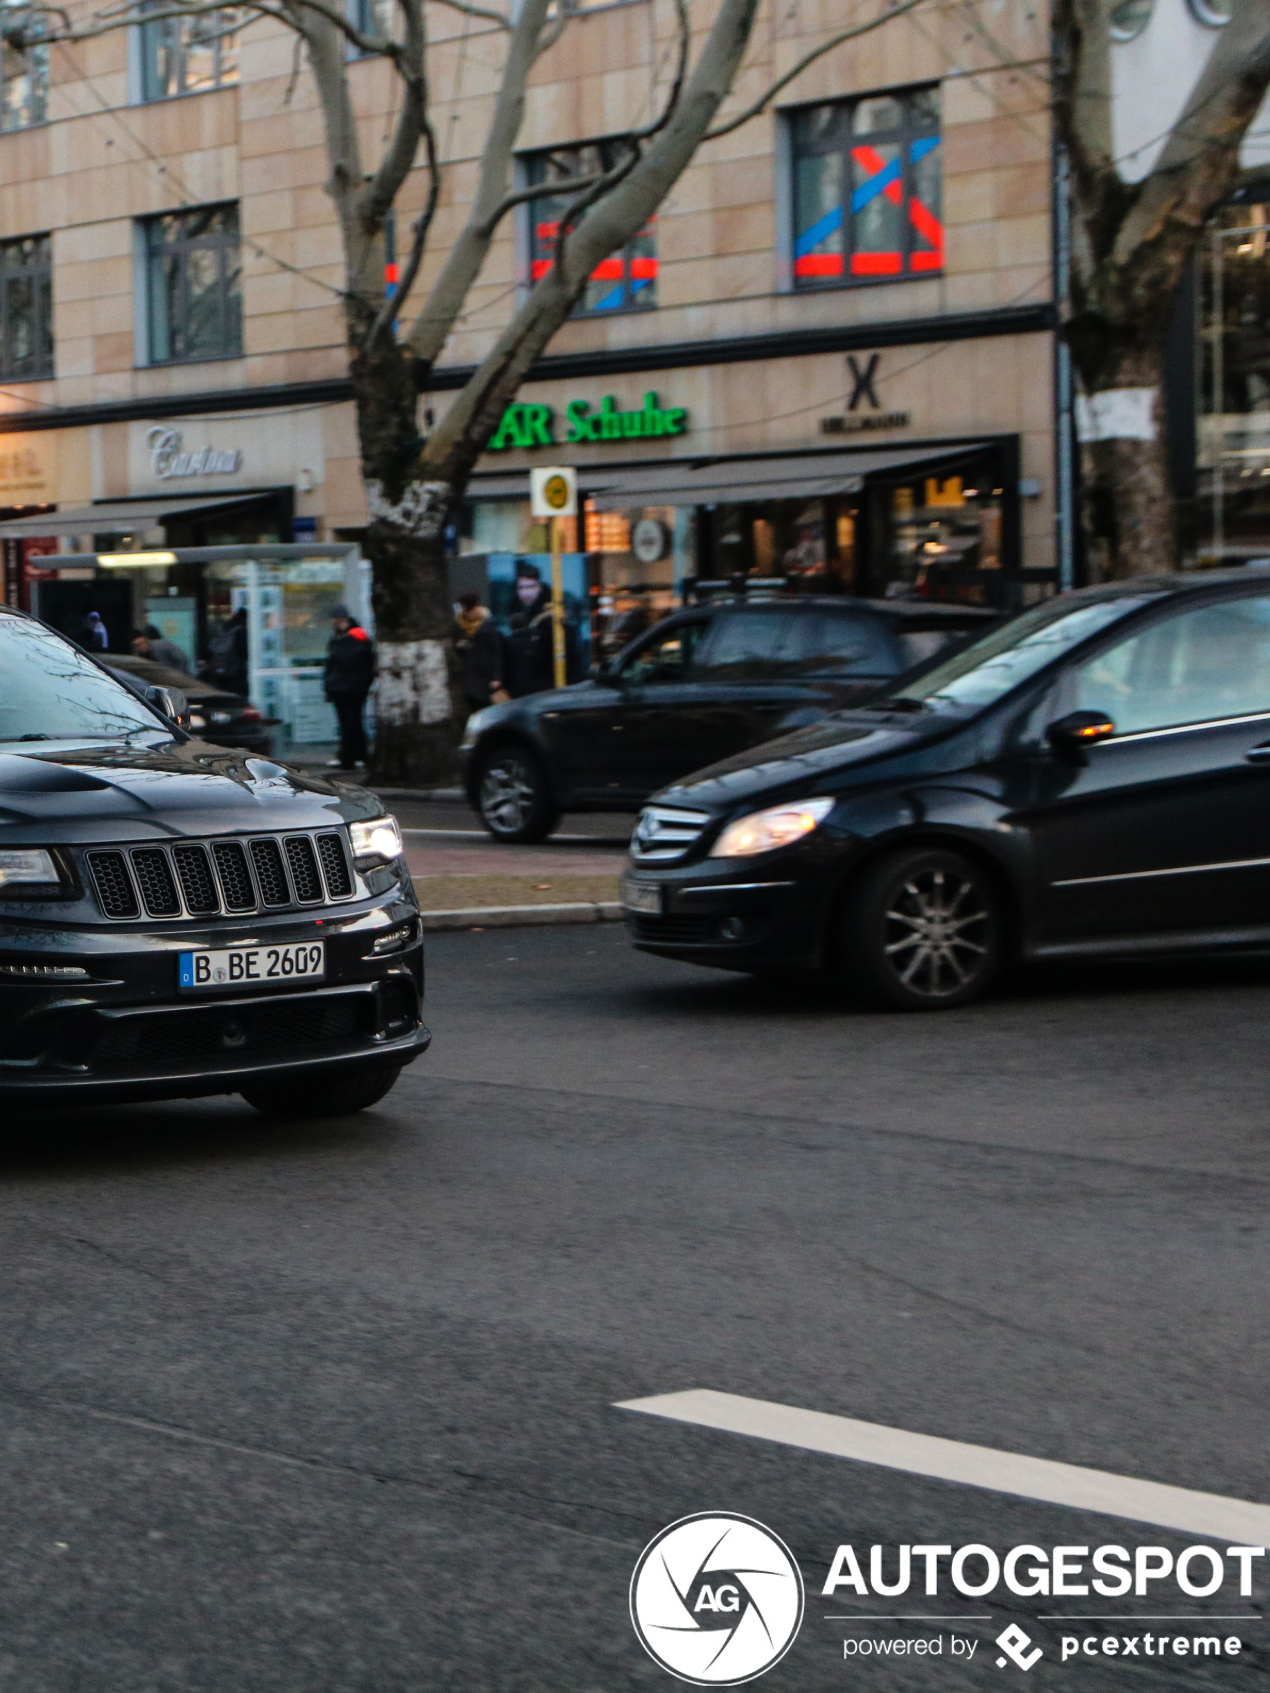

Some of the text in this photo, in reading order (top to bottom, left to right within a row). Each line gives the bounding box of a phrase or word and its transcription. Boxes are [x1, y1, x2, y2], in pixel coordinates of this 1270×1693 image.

[487, 392, 687, 449] AR Schuhe
[195, 945, 322, 983] B BE 2609
